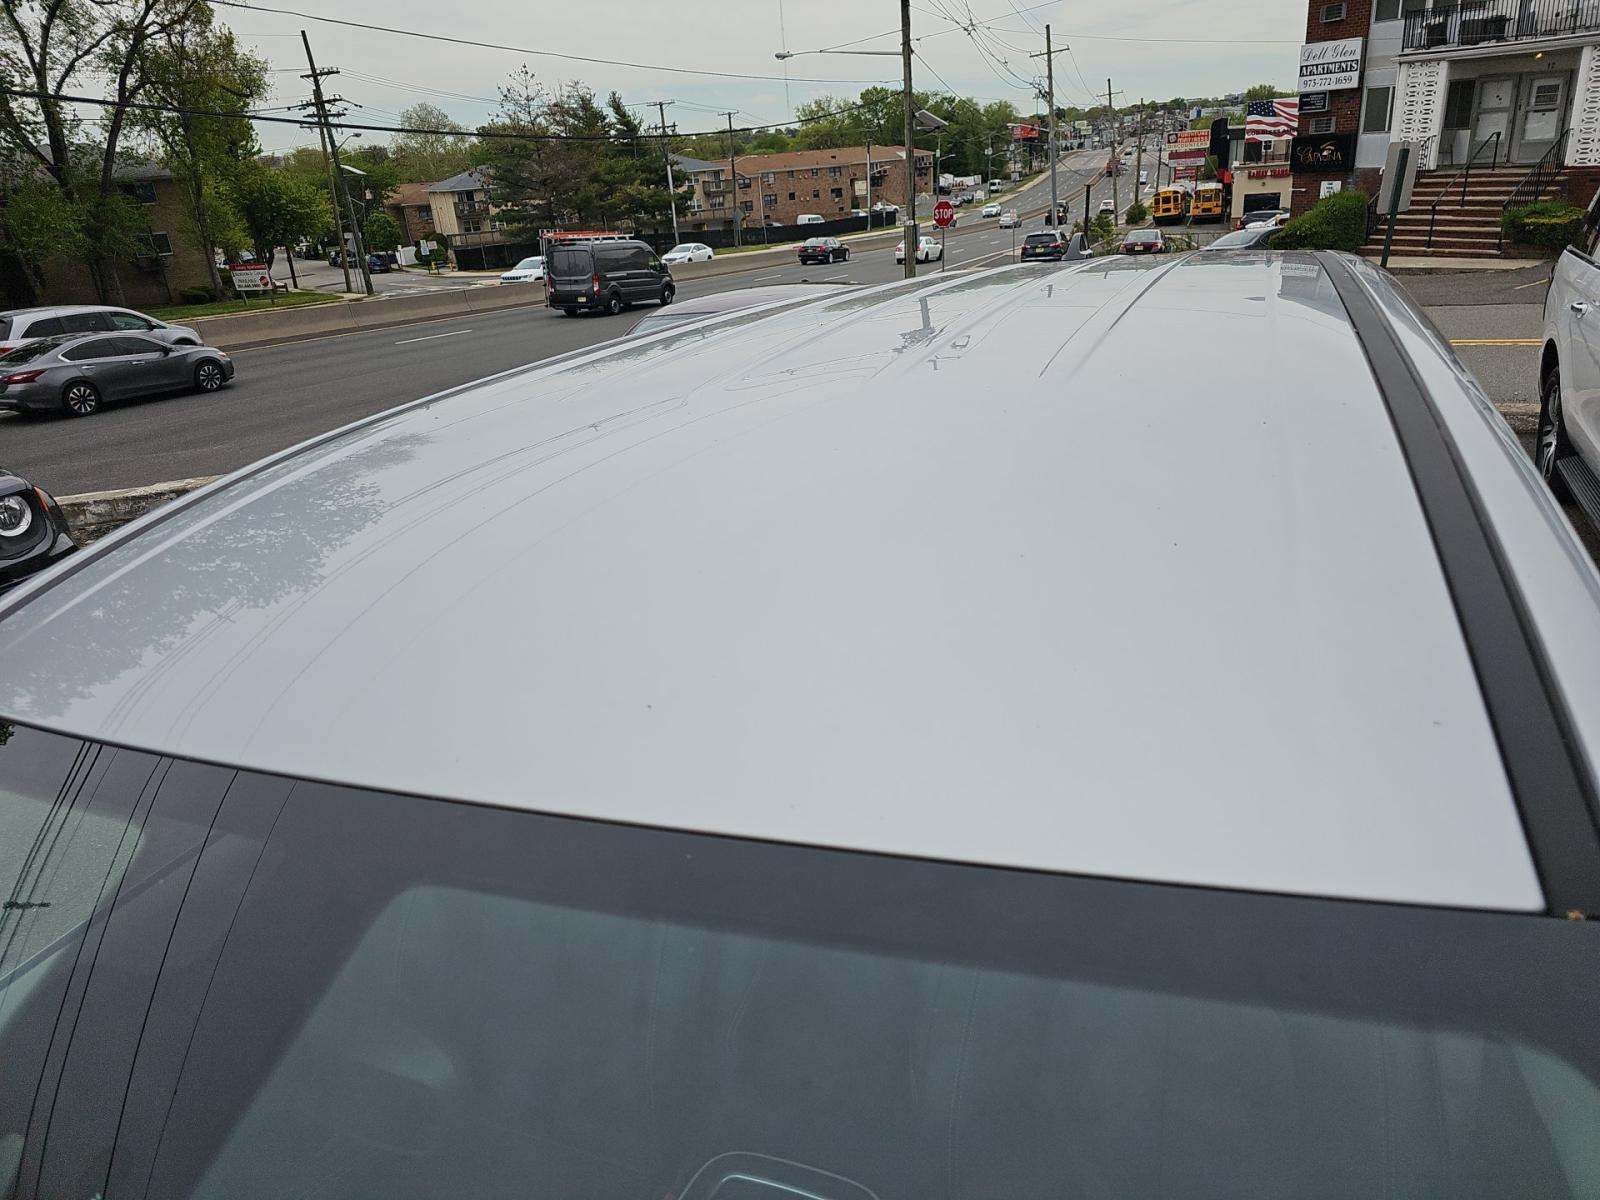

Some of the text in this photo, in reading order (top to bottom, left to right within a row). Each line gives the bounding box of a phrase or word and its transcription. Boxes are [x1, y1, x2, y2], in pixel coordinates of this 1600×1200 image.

[1303, 44, 1356, 61] Dell Glen
[1301, 60, 1357, 76] APARTMENTS
[934, 208, 953, 220] STOP
